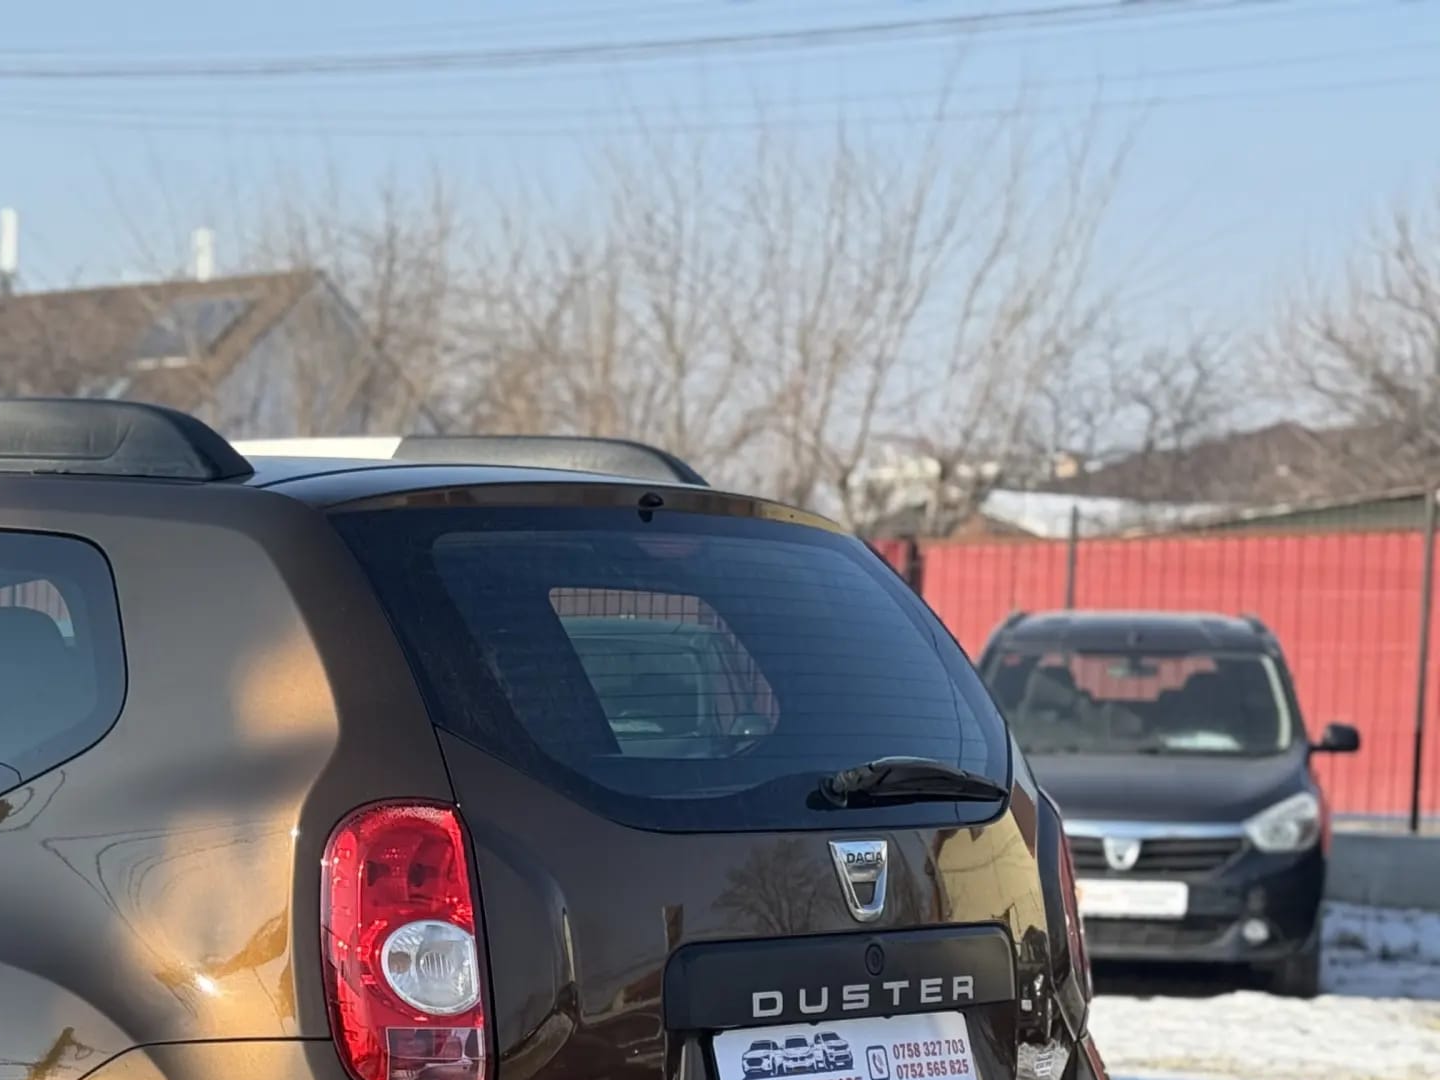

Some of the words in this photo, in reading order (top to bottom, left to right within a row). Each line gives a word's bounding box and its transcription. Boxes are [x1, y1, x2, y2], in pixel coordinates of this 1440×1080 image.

[846, 851, 884, 864] DACIA
[752, 974, 975, 1018] DUSTER
[892, 1042, 921, 1060] 0758
[922, 1040, 942, 1057] 327
[944, 1038, 966, 1055] 703
[896, 1062, 925, 1080] 0752
[926, 1060, 948, 1077] 565
